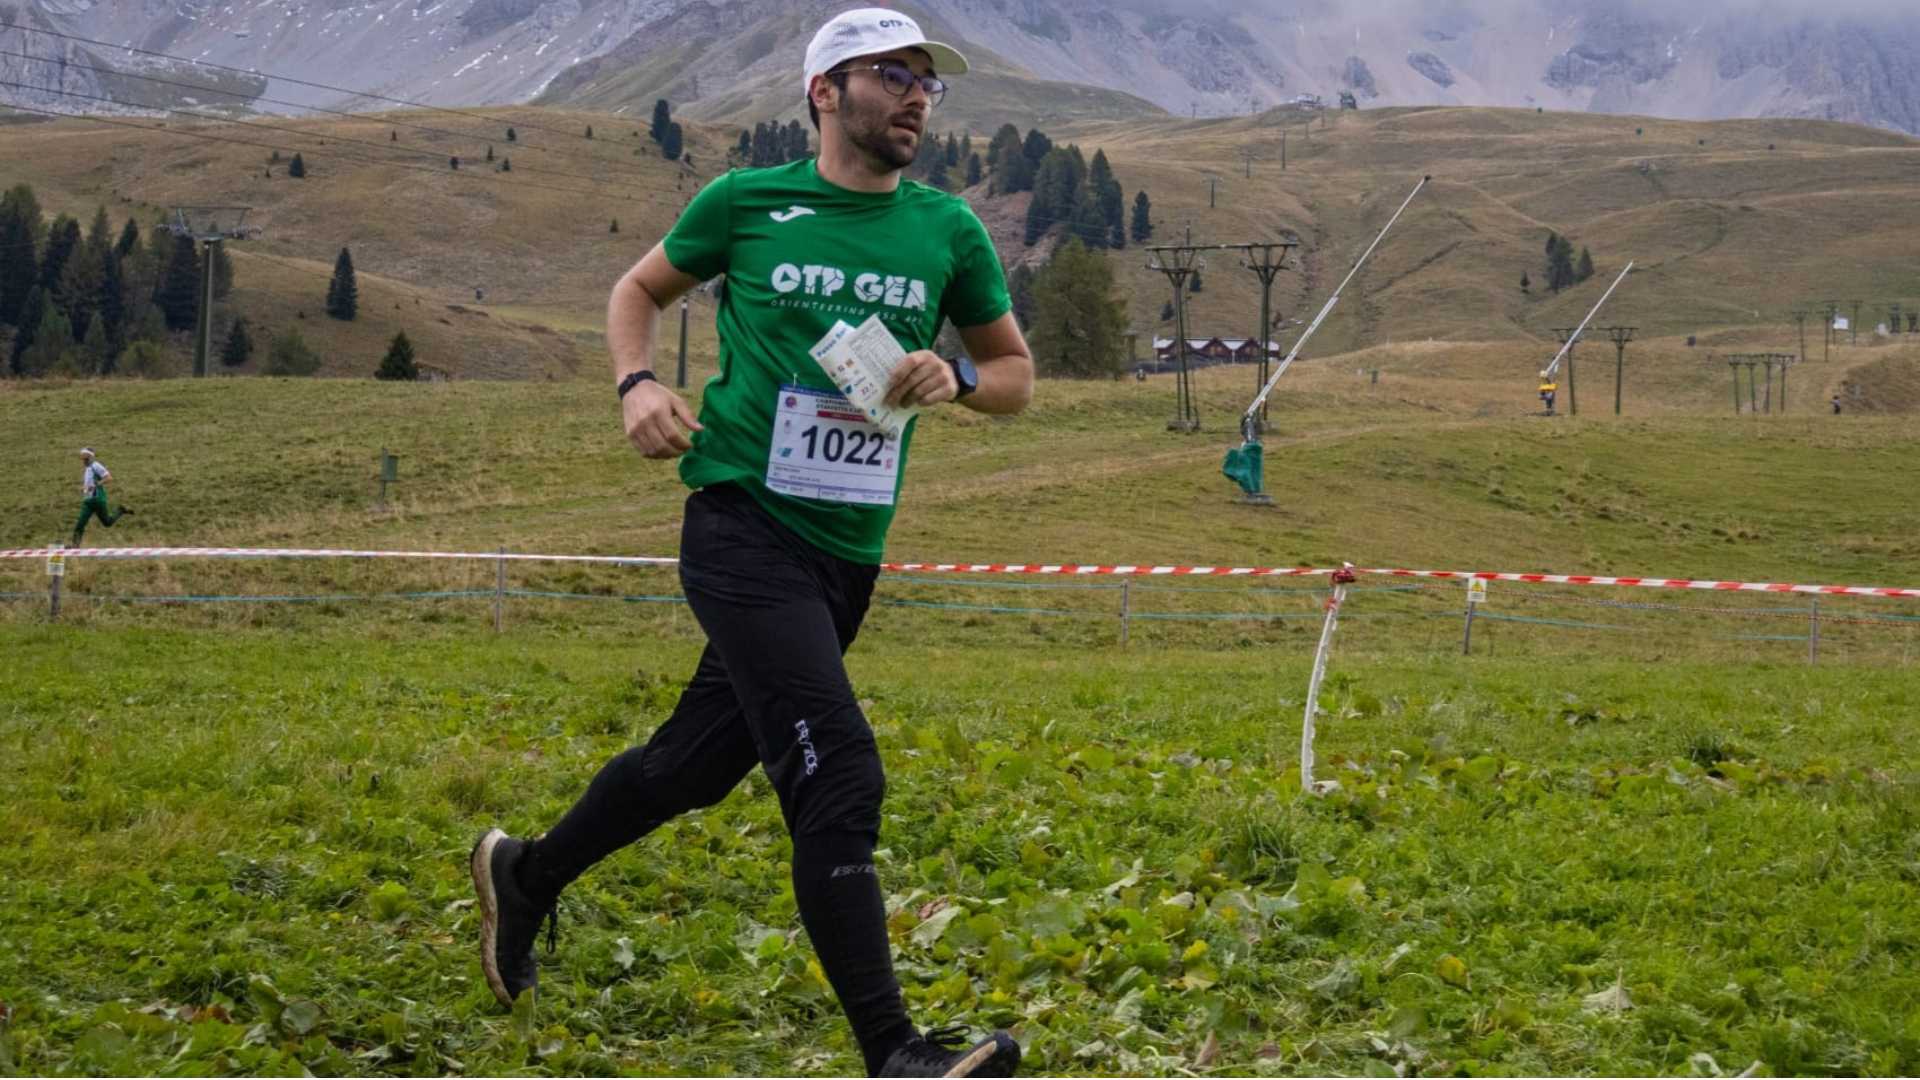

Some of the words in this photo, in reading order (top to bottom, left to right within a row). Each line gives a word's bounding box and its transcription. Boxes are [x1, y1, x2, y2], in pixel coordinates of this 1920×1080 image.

[770, 299, 865, 316] ORIENTEERING
[771, 263, 845, 296] OTP
[854, 272, 926, 311] GEA
[801, 425, 885, 466] 1022
